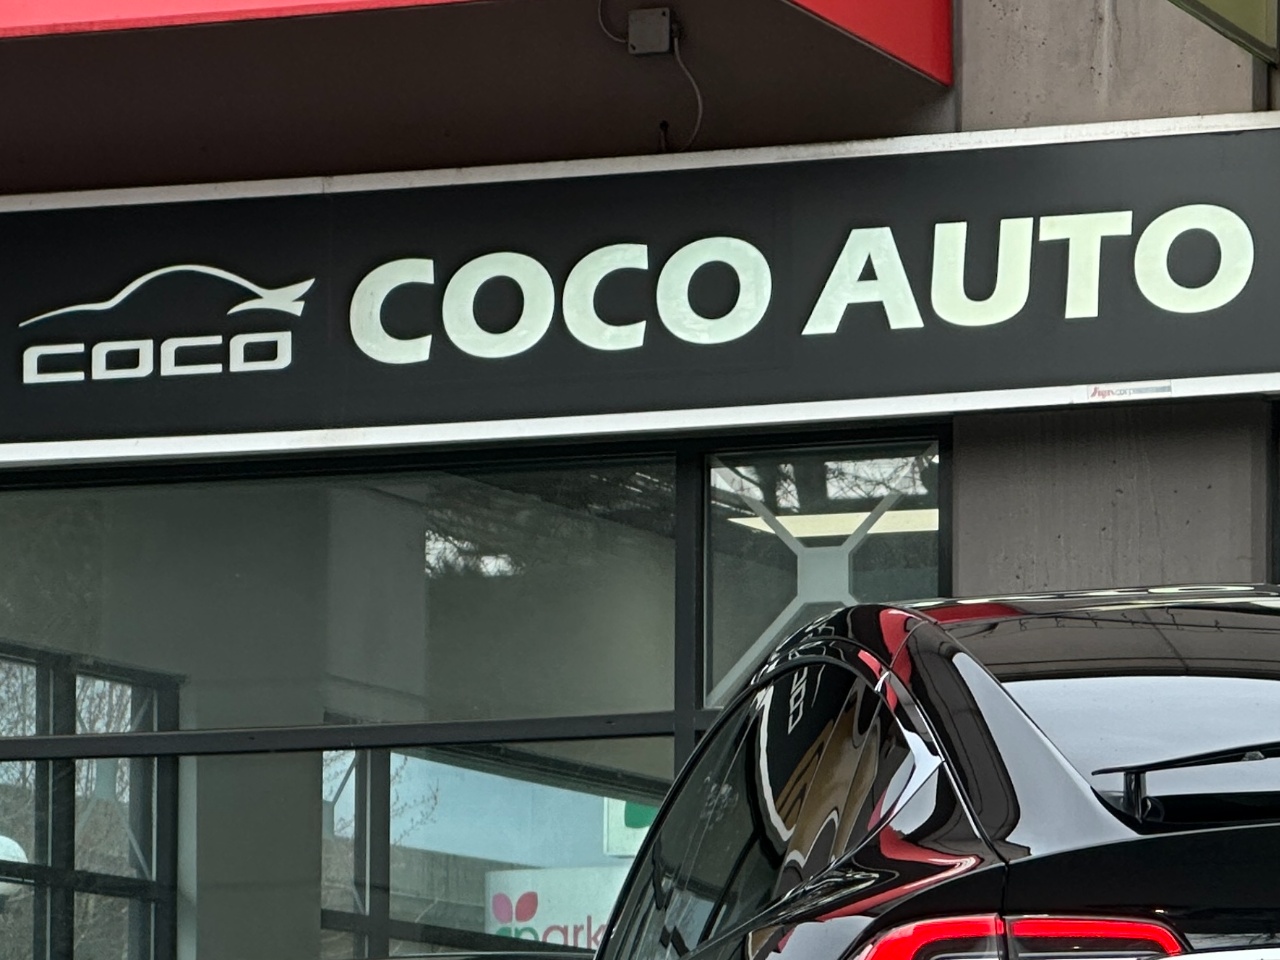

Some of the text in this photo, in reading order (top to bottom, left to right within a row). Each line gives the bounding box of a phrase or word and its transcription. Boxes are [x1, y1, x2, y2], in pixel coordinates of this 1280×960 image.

[349, 203, 1255, 365] COCO AUTO
[22, 330, 292, 384] COCO
